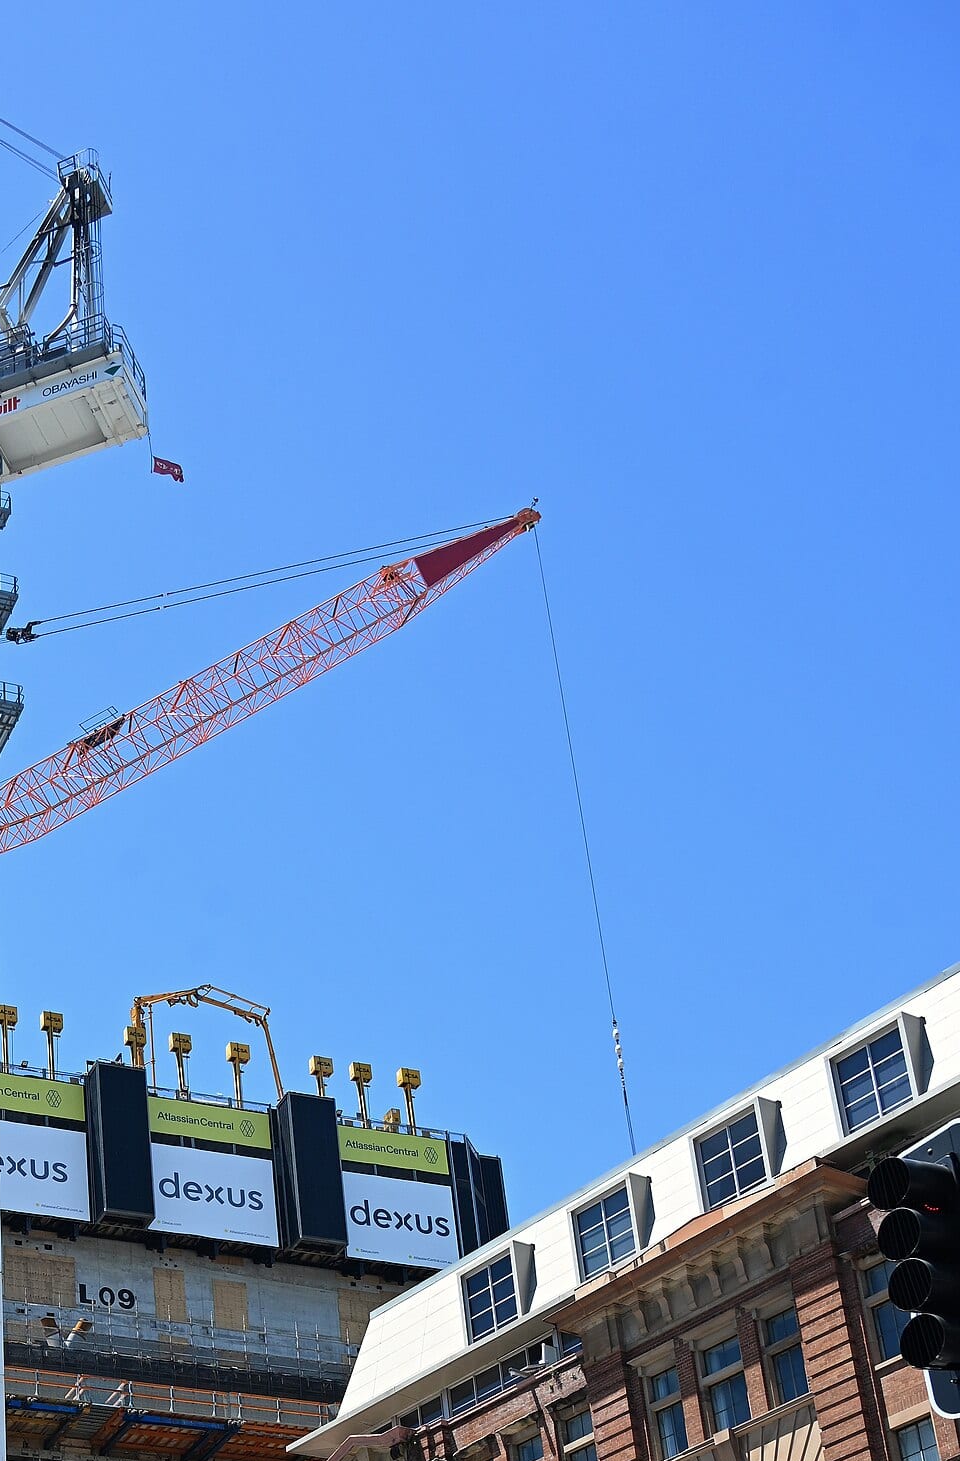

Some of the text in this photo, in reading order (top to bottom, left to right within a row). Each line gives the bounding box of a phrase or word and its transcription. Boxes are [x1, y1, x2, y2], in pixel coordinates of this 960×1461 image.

[42, 371, 97, 397] OBAYASHI
[158, 1172, 264, 1211] dexus
[350, 1199, 450, 1237] dexus
[79, 1284, 136, 1310] L09
